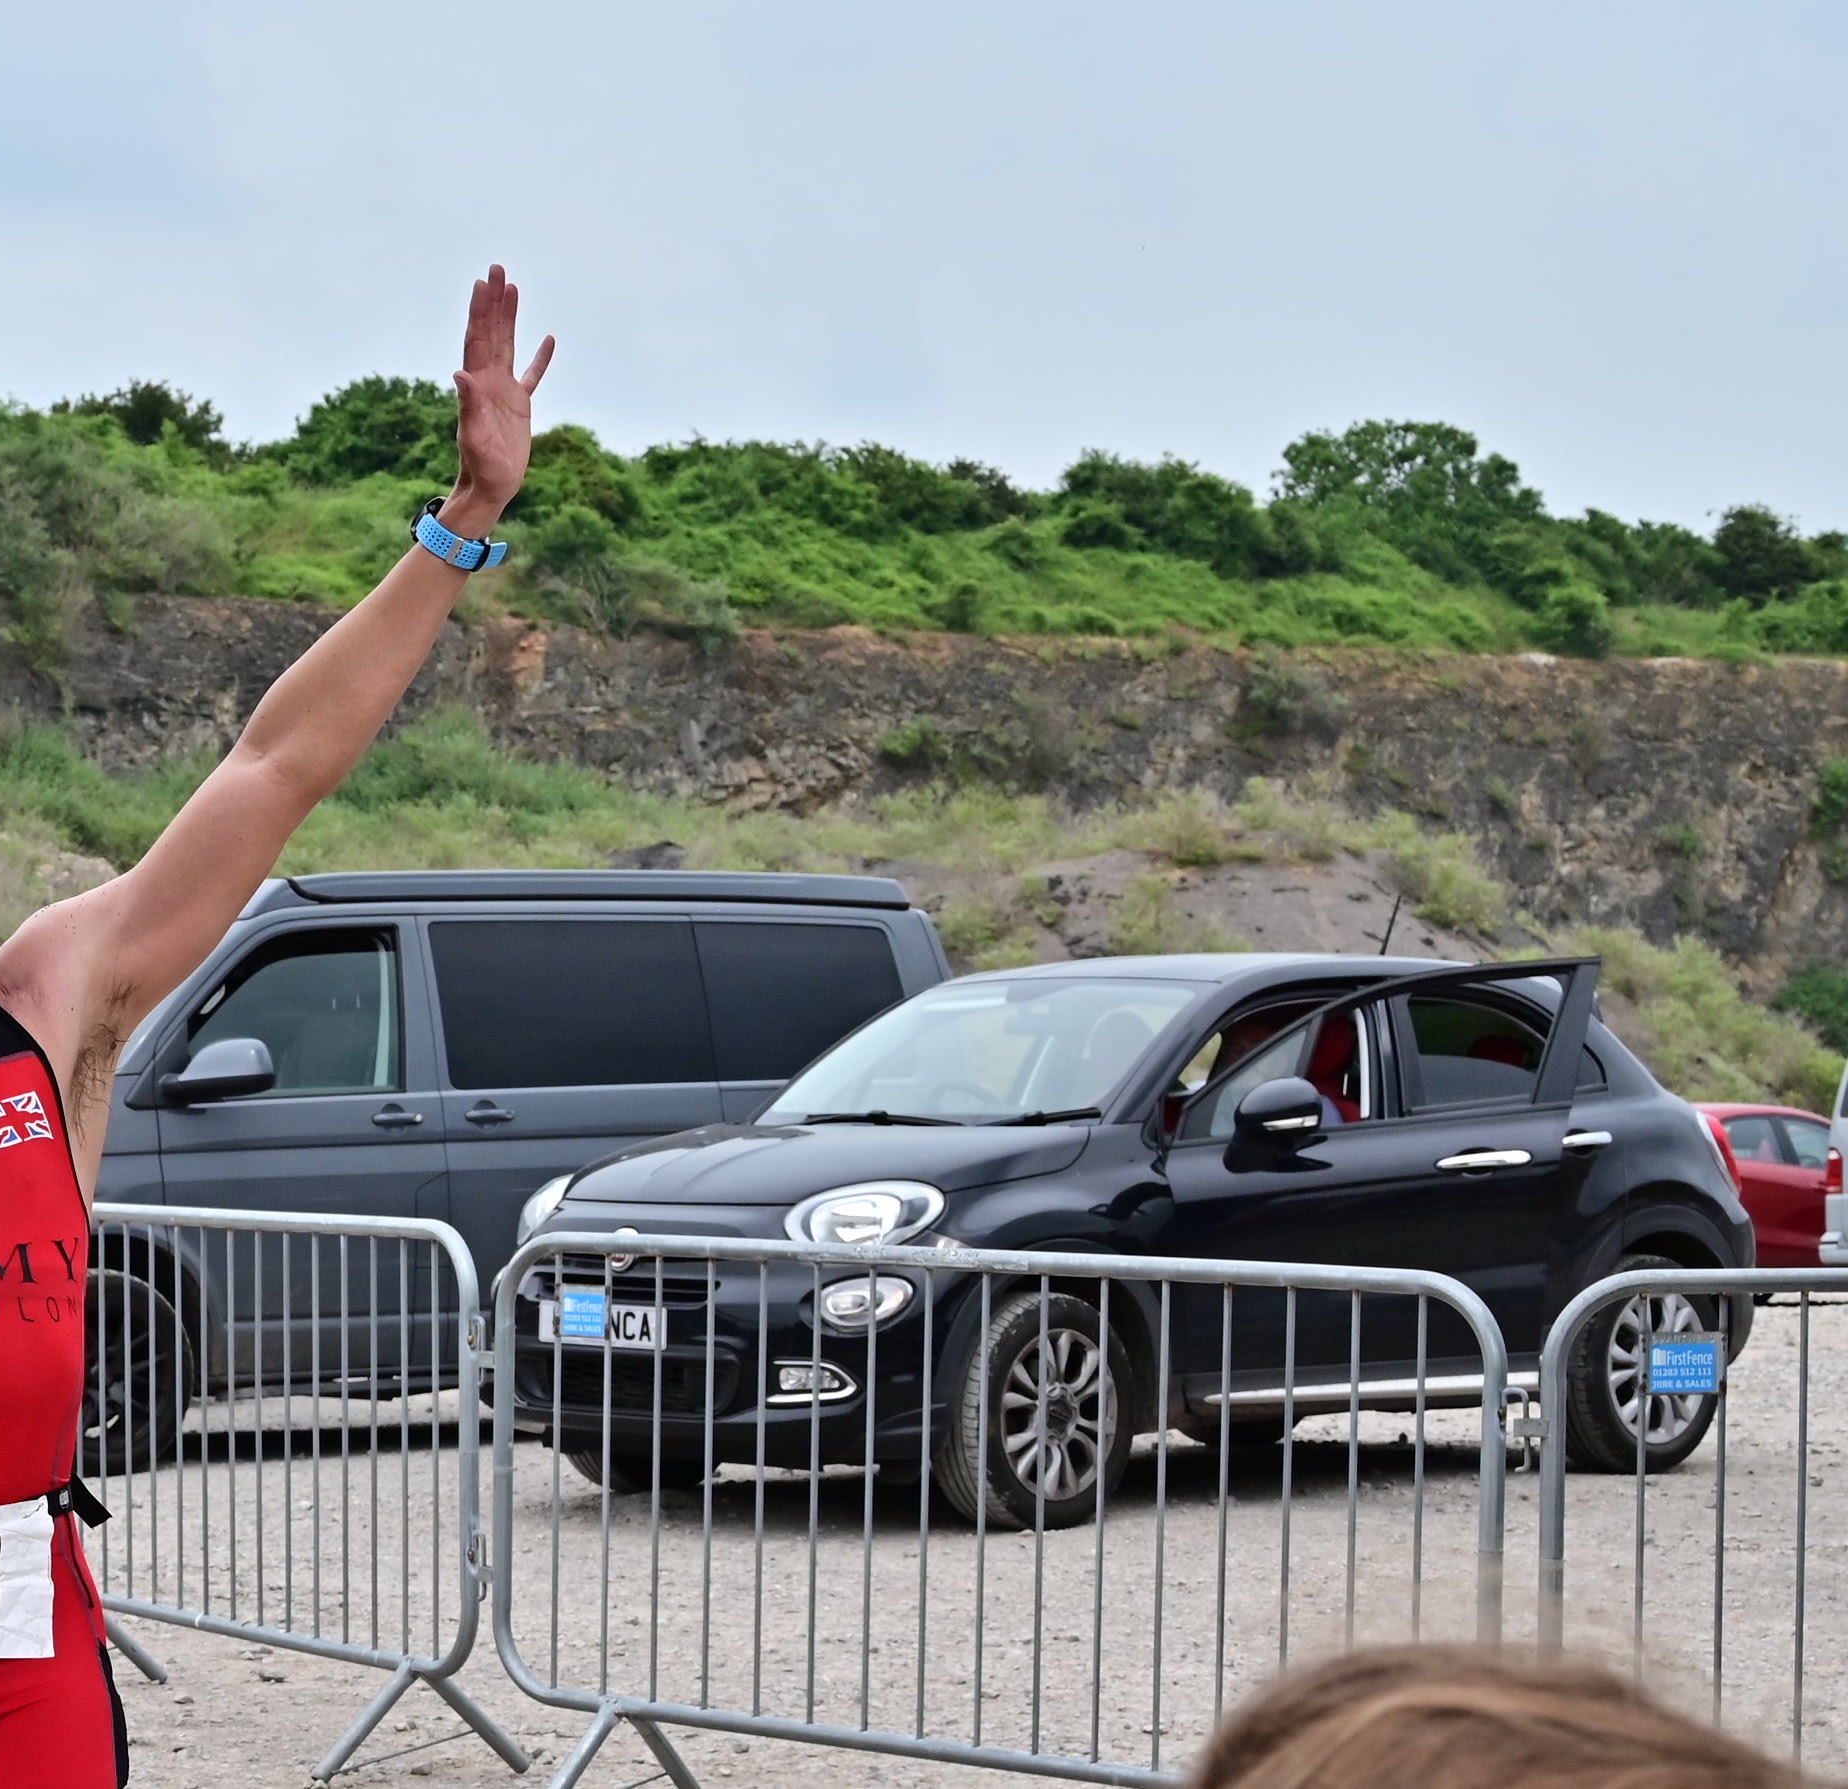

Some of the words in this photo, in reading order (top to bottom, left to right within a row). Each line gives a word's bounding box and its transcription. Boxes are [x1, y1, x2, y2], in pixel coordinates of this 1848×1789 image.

[1667, 1350, 1713, 1366] FirstFence
[1653, 1368, 1678, 1376] 01283
[1680, 1368, 1695, 1376] 512
[1697, 1367, 1711, 1376] 111
[1676, 1379, 1683, 1388] &
[1685, 1379, 1712, 1388] SALES
